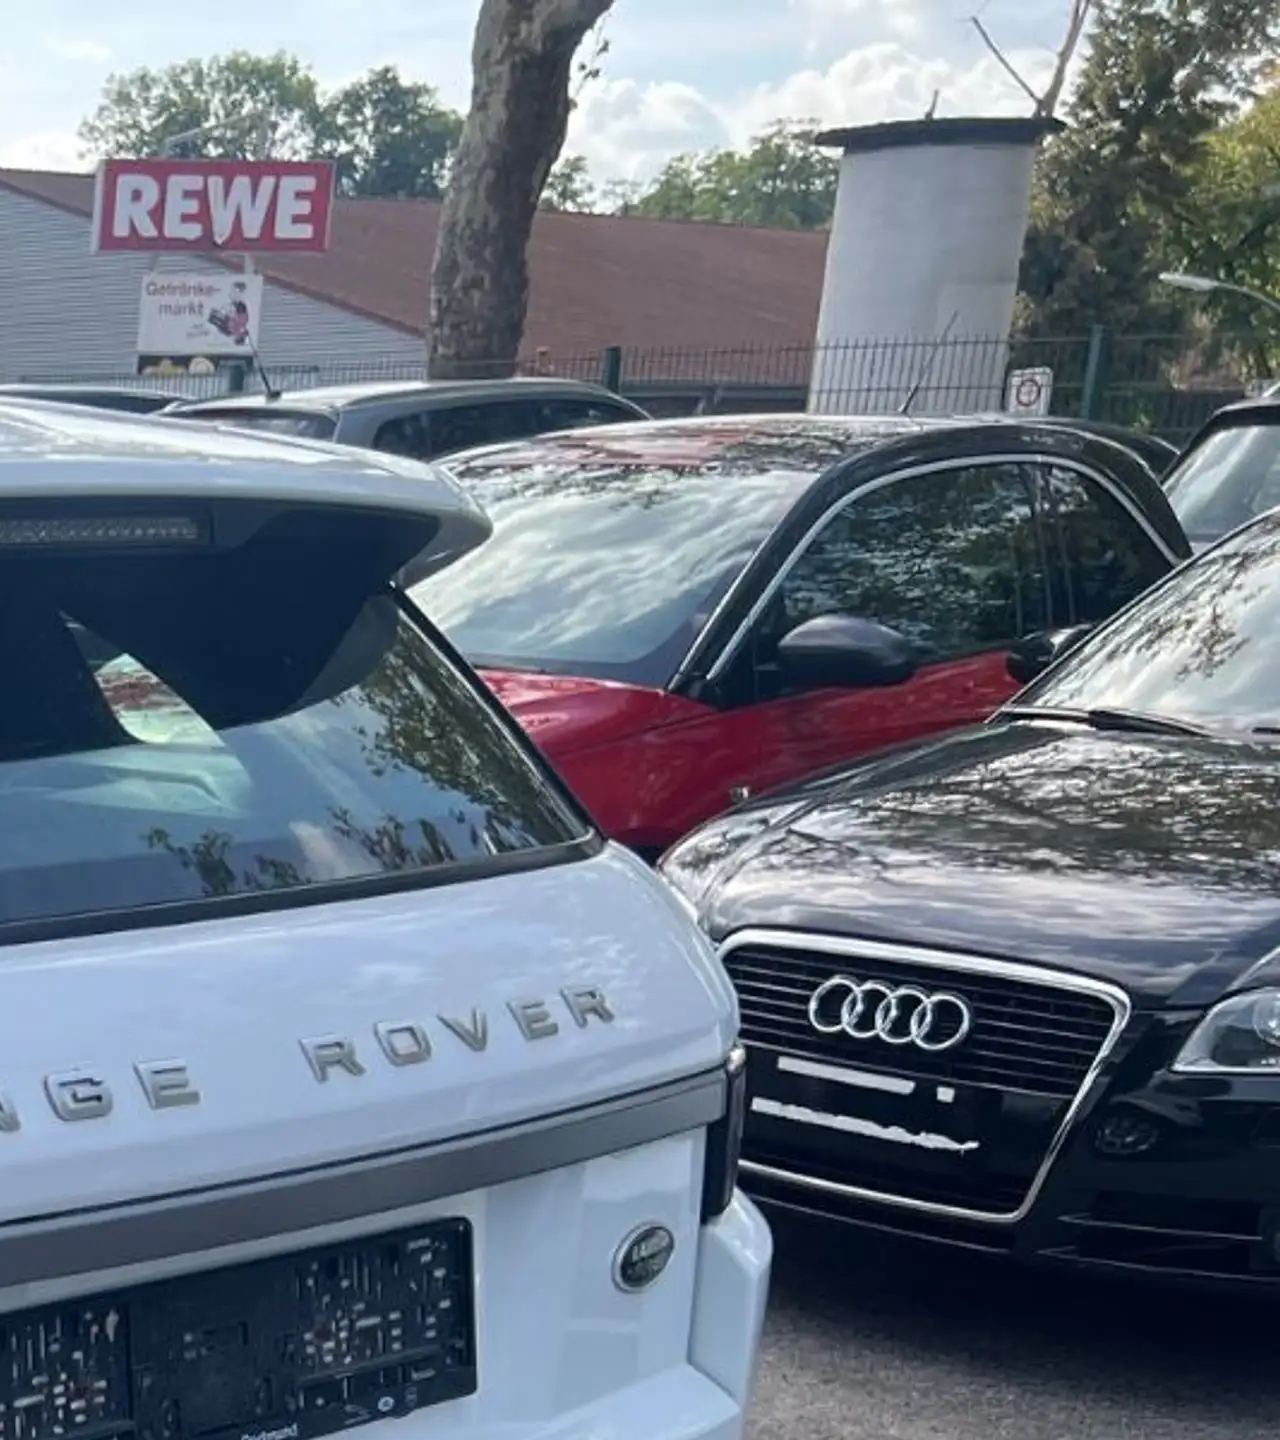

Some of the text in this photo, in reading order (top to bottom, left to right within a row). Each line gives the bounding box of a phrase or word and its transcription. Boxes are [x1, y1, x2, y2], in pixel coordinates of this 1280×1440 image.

[113, 174, 317, 245] REWE
[159, 301, 204, 318] markt
[300, 983, 618, 1082] ROVER
